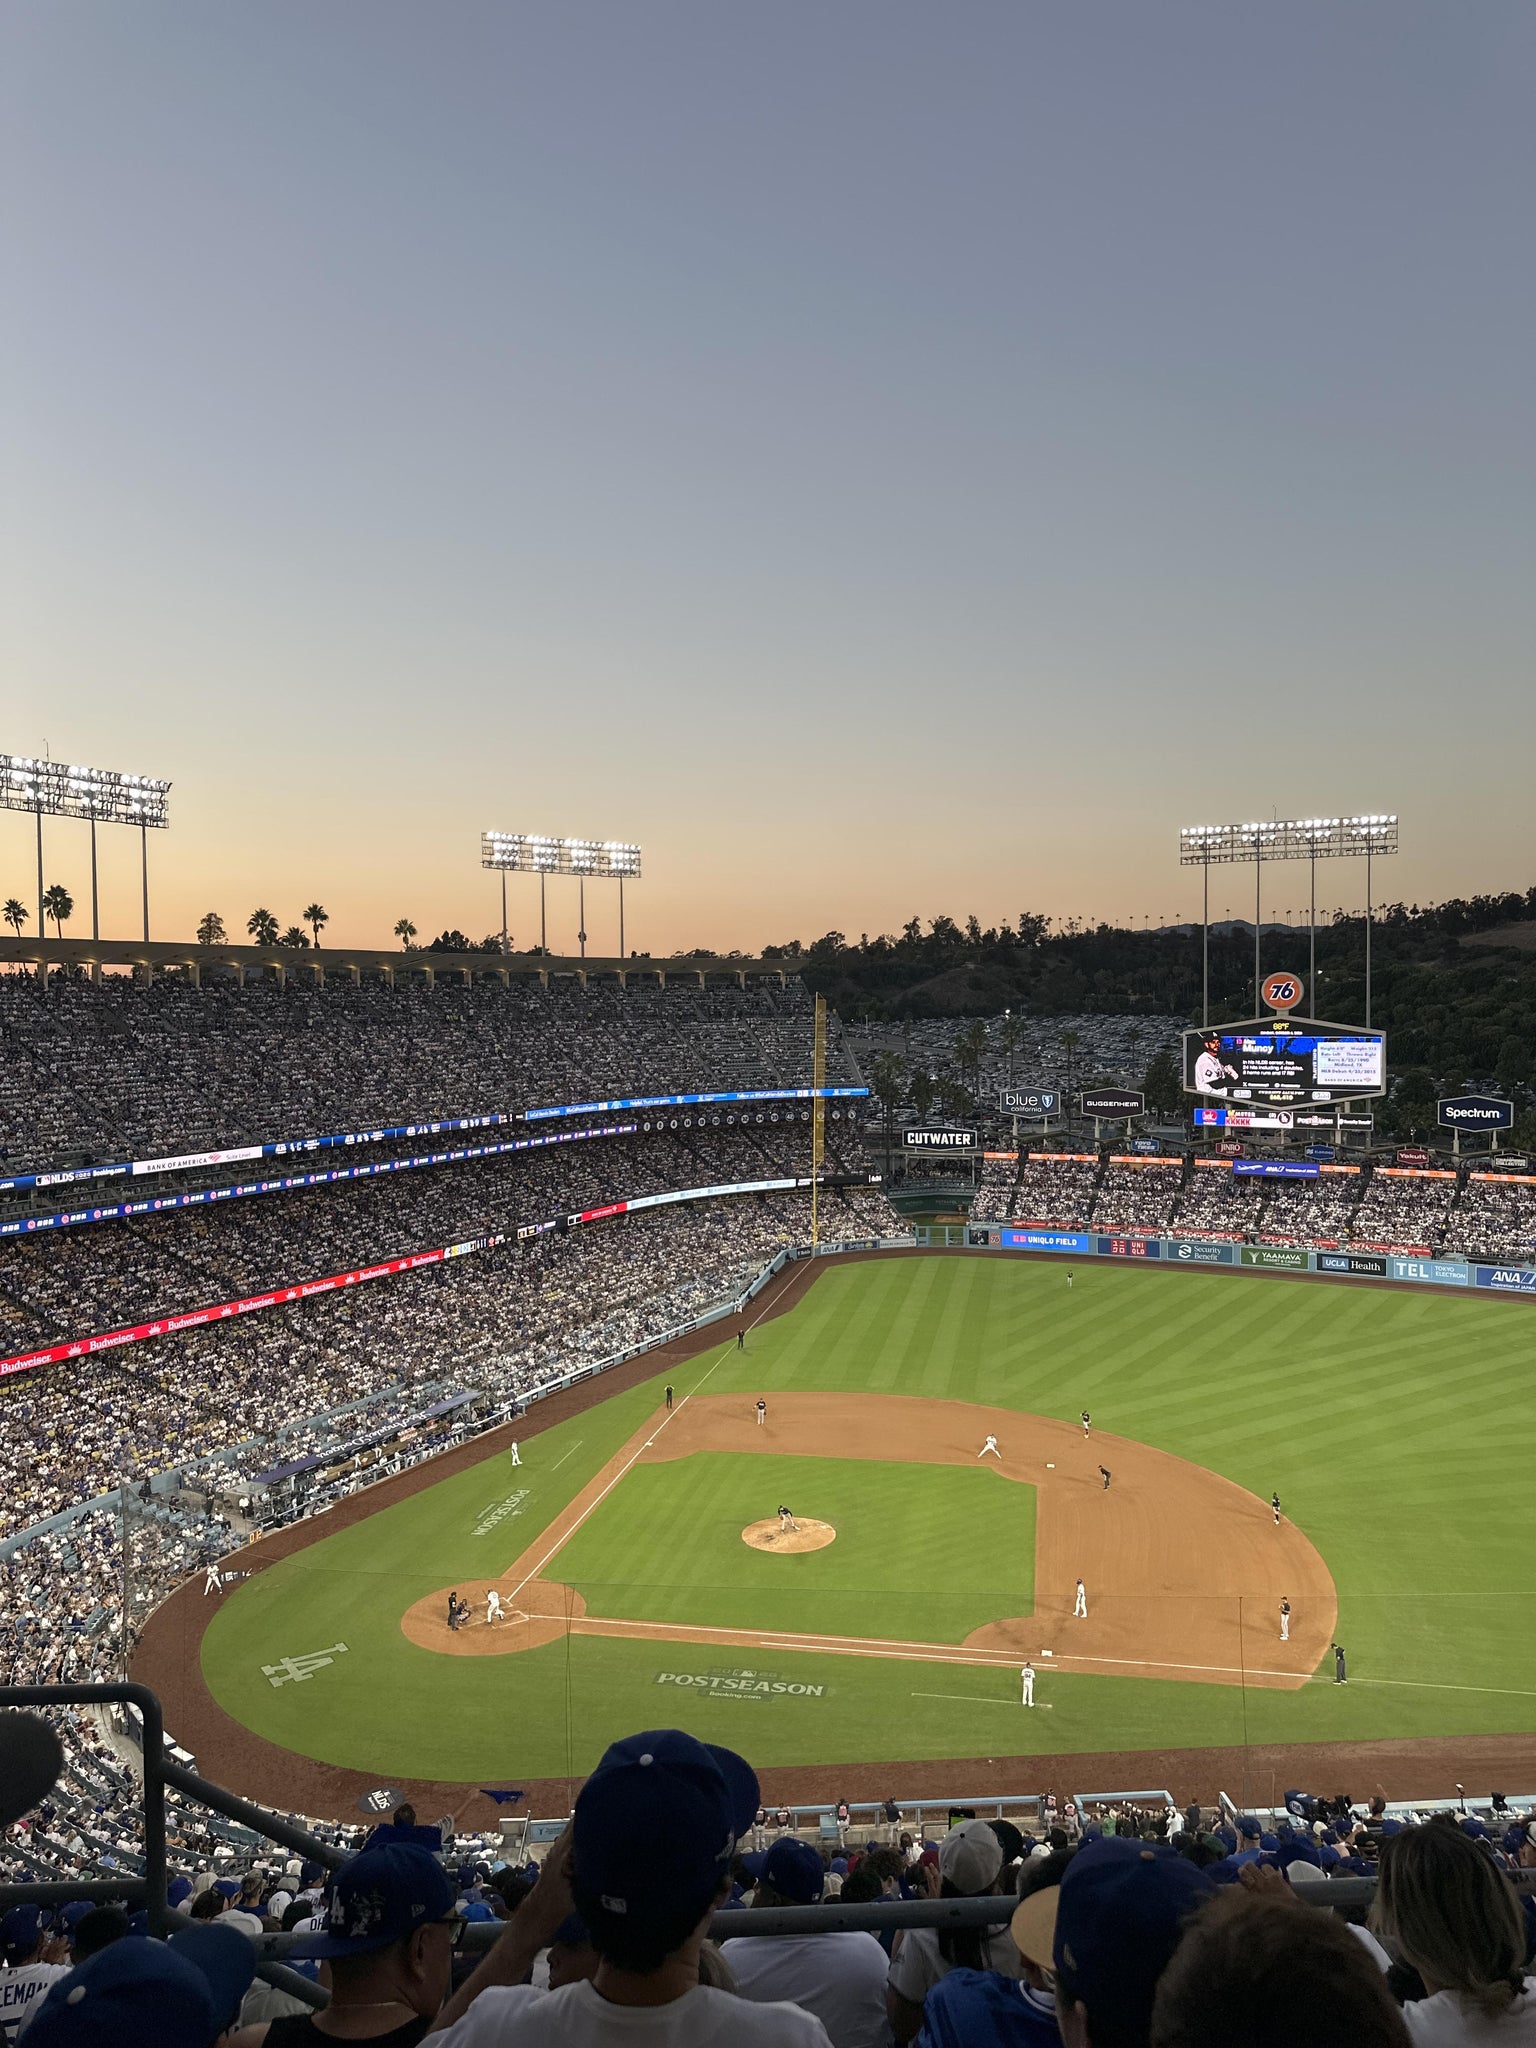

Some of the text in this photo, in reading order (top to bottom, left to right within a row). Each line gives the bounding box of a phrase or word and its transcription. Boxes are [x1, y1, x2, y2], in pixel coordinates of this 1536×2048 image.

[1270, 982, 1294, 1000] 76
[1243, 1045, 1274, 1054] Muncy
[1006, 1093, 1038, 1106] blue
[1086, 1100, 1139, 1108] GUGGENHEIM
[1445, 1106, 1499, 1120] Spectrum
[907, 1132, 971, 1145] CUTWATER
[1220, 1143, 1240, 1152] JINRO
[147, 1163, 167, 1171] BANK
[178, 1158, 208, 1167] AMERICA
[51, 1172, 75, 1184] NLDS
[93, 1167, 126, 1177] Booking.com
[1028, 1236, 1077, 1246] UNIQLO FIELD
[1194, 1246, 1221, 1255] Security
[1194, 1252, 1218, 1261] Benefit
[1325, 1259, 1381, 1272] UCLA Health
[1396, 1263, 1429, 1278] TEL
[1435, 1271, 1466, 1280] ELECTRON
[1491, 1271, 1520, 1283] ANA
[471, 1490, 531, 1536] POSTSEASON
[657, 1673, 823, 1696] POSTSEASON
[709, 1691, 761, 1700] Booking.com
[372, 1790, 390, 1809] NLDS
